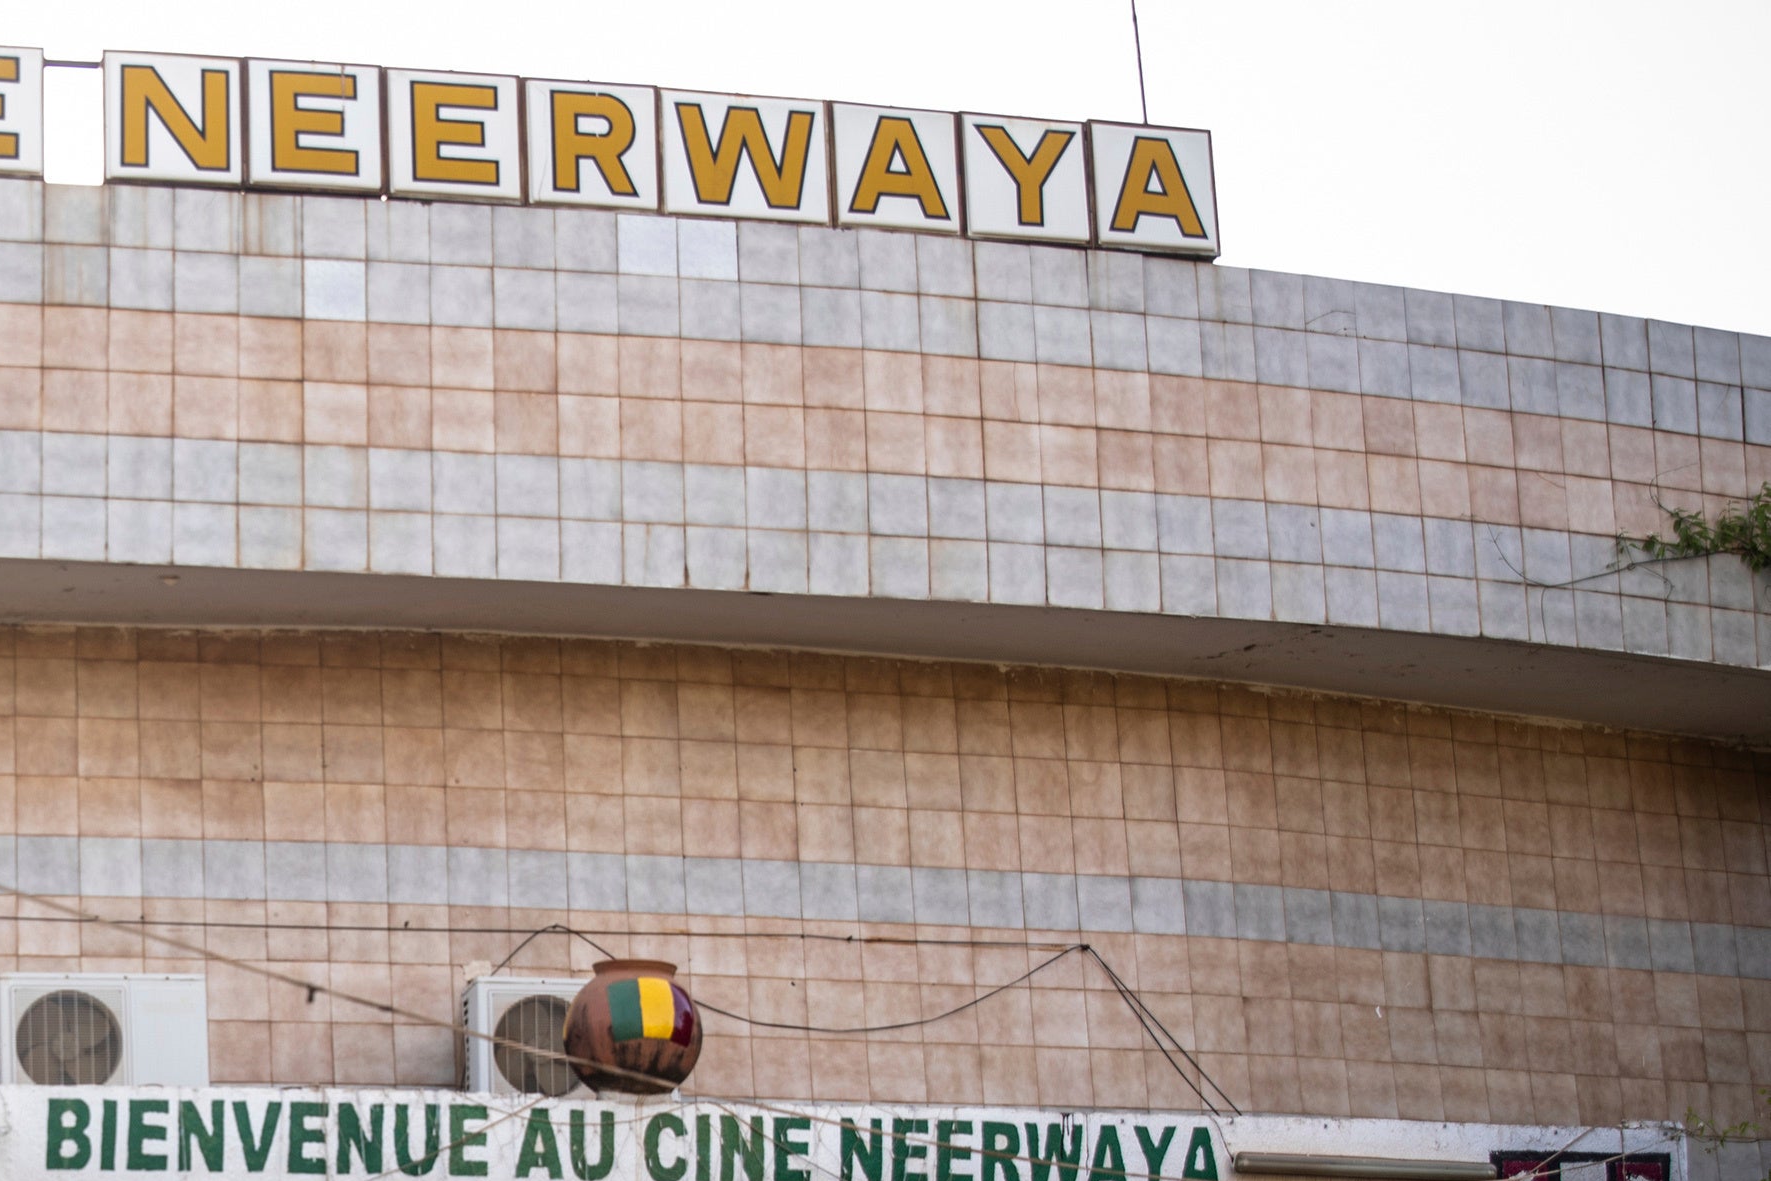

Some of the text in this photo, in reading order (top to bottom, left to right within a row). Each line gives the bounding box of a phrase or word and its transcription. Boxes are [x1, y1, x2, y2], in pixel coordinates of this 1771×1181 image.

[120, 64, 1208, 239] NEERWAYA
[45, 1097, 489, 1178] BIENVENUE
[515, 1107, 615, 1181] AU
